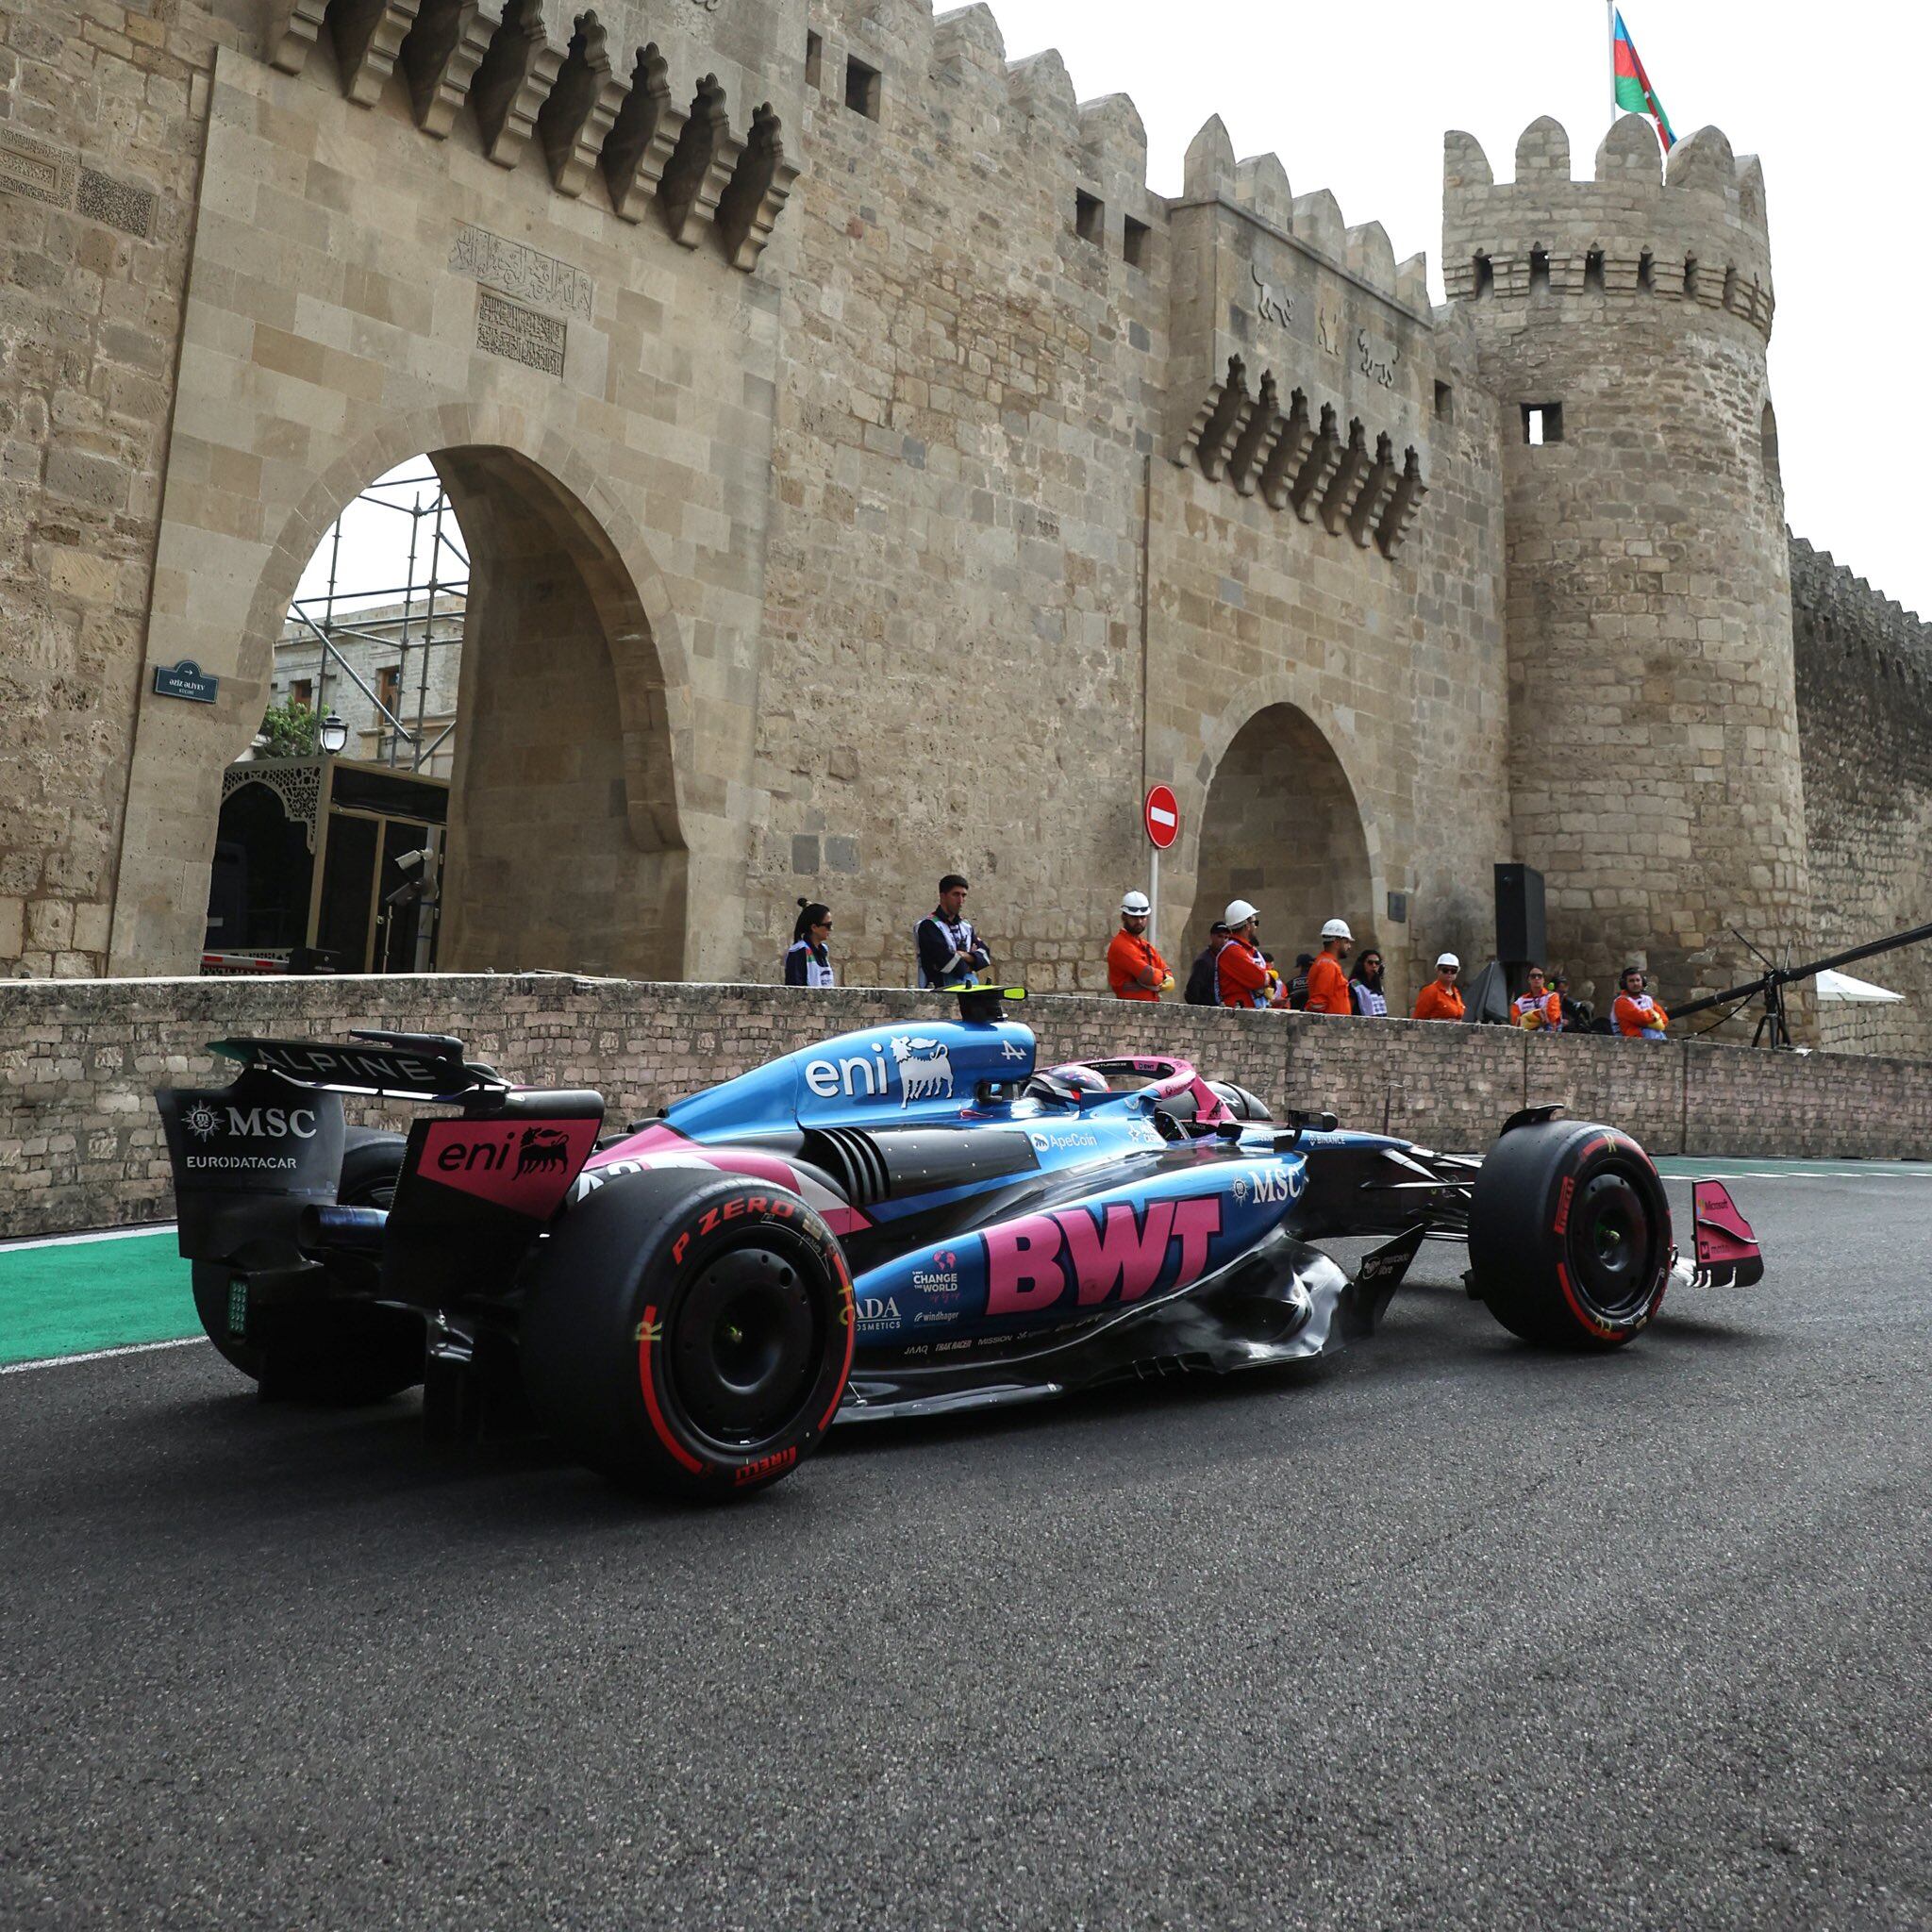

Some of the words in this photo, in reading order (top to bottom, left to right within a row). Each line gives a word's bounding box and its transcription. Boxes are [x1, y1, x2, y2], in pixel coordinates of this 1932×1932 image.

[258, 1047, 436, 1081] ALPINE
[805, 1042, 888, 1097] eni
[225, 1107, 318, 1139] MSC
[437, 1131, 516, 1172] eni
[1049, 1133, 1097, 1150] ApeCoin
[186, 1156, 297, 1169] EURODATACAR
[1247, 1166, 1301, 1204] MSC
[672, 1230, 691, 1265] P
[698, 1196, 795, 1236] ZERO
[981, 1197, 1221, 1315] BWT
[913, 1274, 958, 1284] CHANGE
[923, 1283, 958, 1292] WORLD
[857, 1321, 901, 1331] OSMETICS
[977, 1335, 1013, 1346] MISSION
